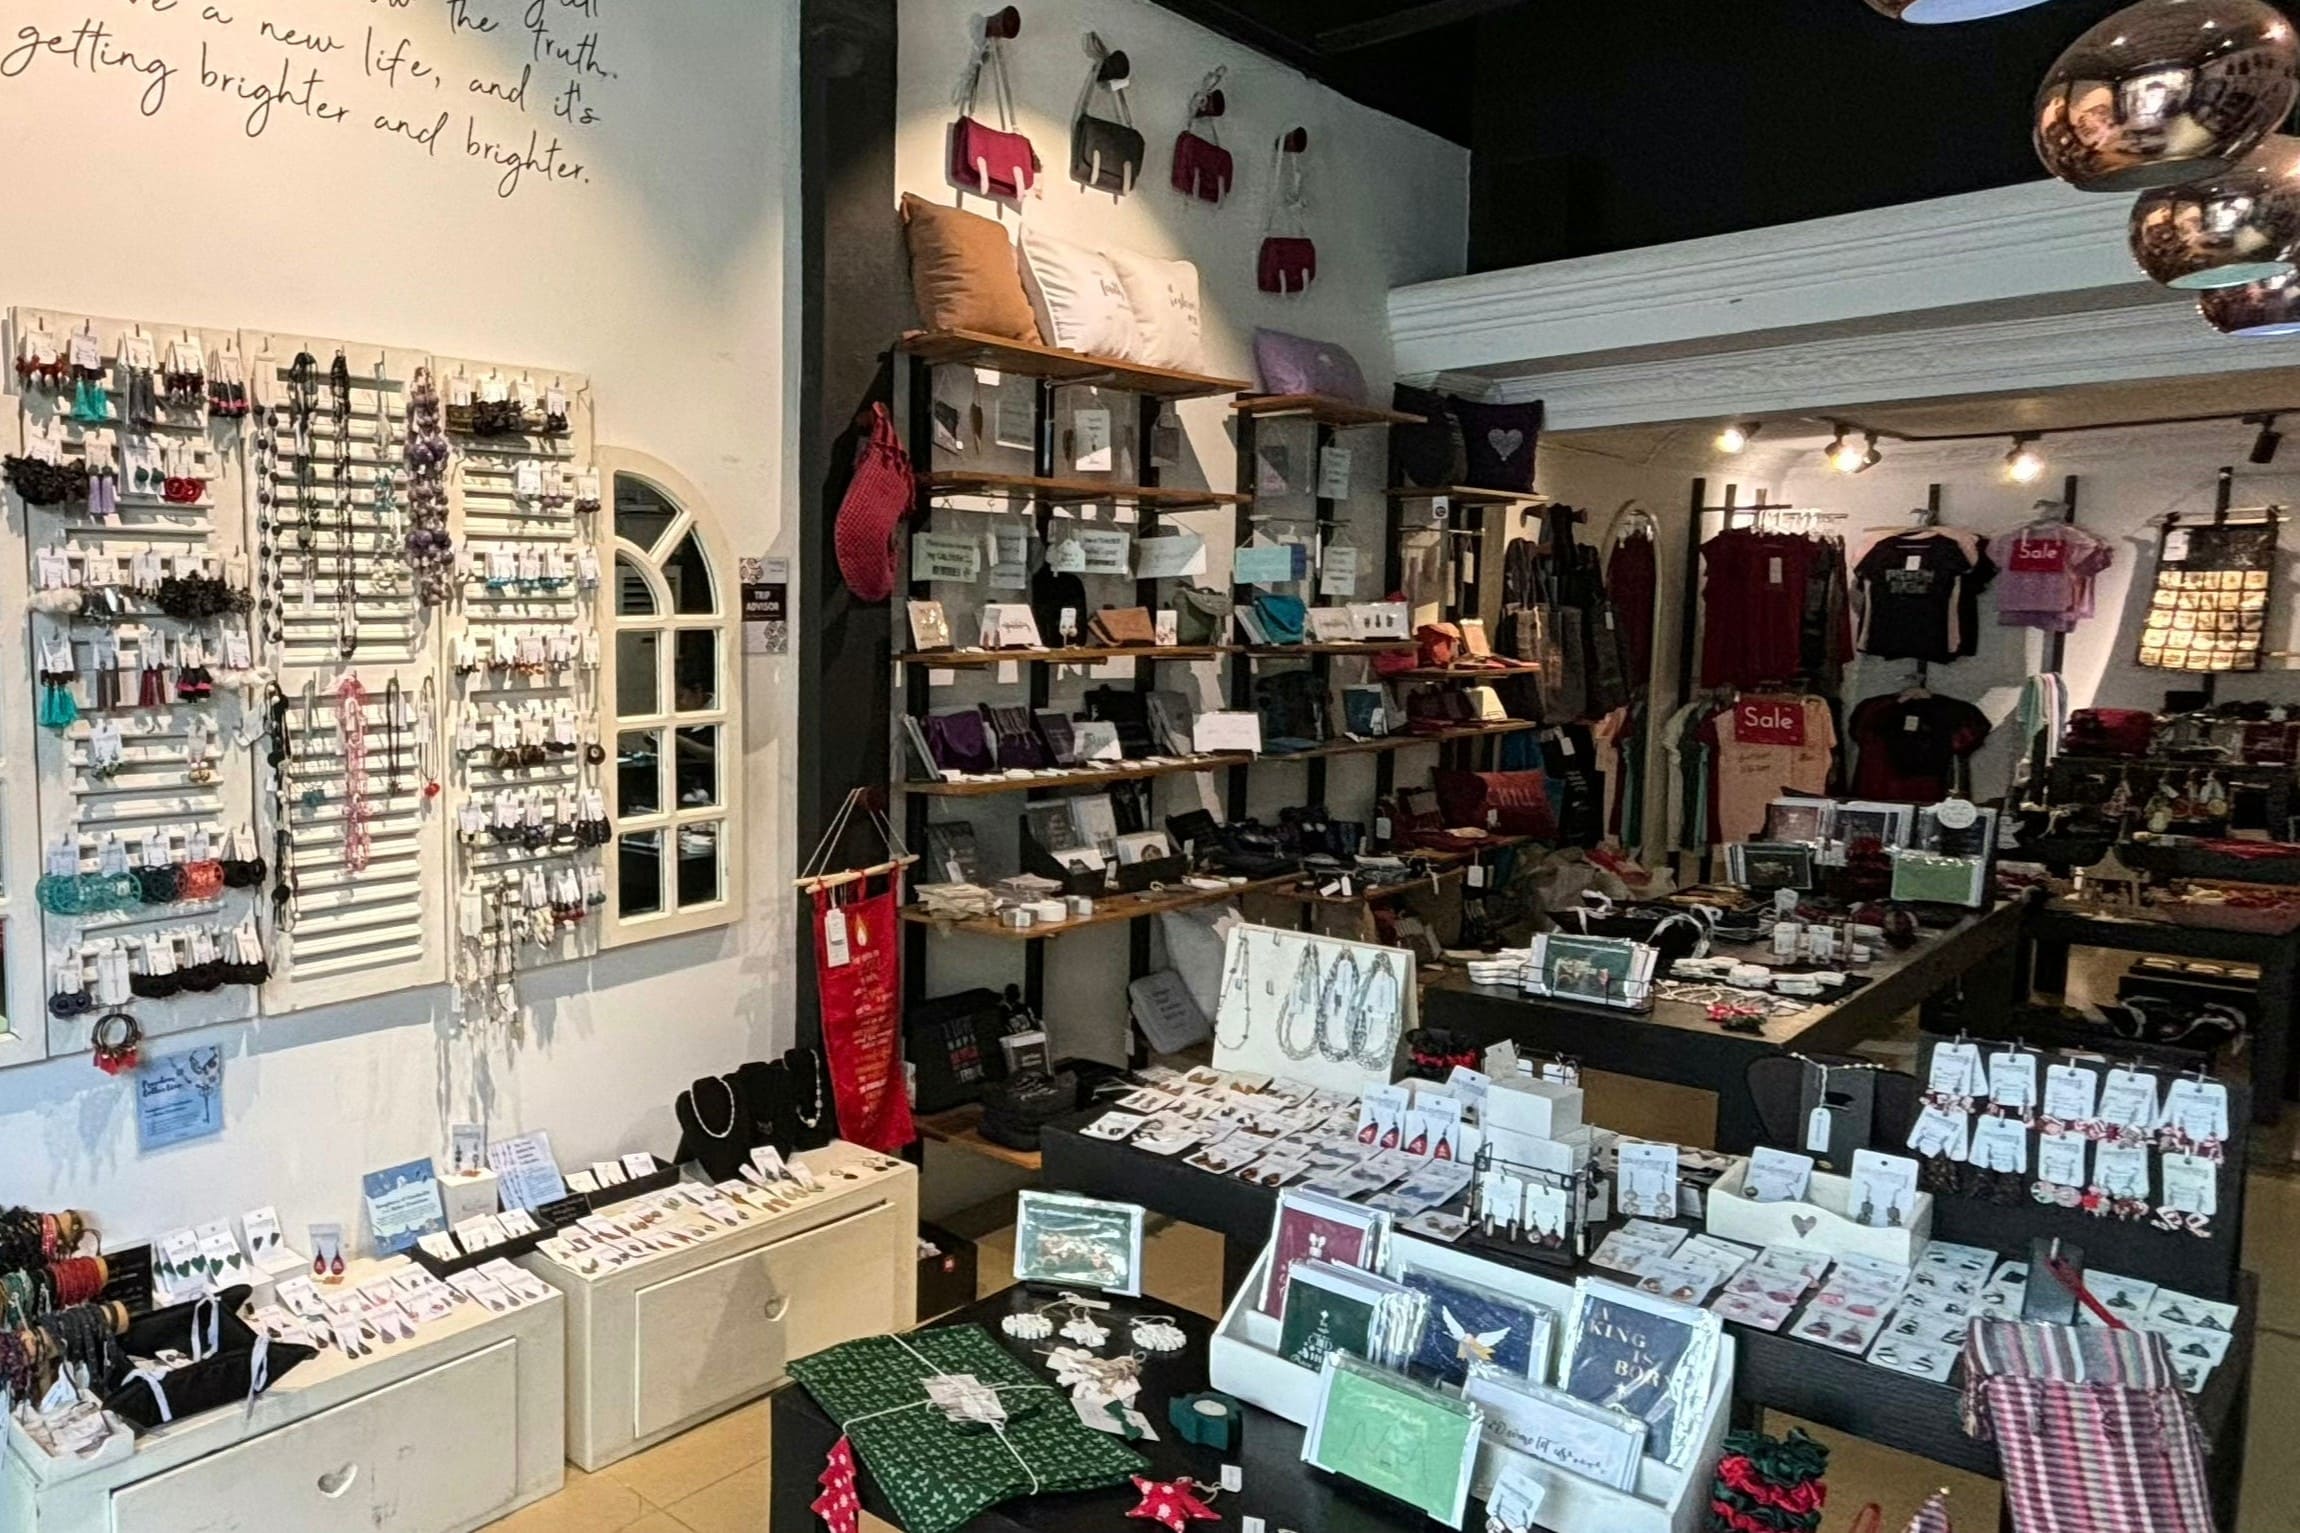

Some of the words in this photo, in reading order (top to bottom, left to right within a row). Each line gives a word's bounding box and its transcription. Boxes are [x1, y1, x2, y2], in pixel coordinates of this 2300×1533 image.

[202, 5, 233, 24] a
[260, 21, 344, 52] new
[365, 26, 440, 88] life,
[469, 64, 531, 112] and
[554, 79, 600, 124] it's
[447, 0, 498, 33] the
[532, 20, 618, 79] truth.
[1, 18, 178, 116] getting
[200, 41, 349, 138] brighter
[374, 112, 449, 156] and
[466, 116, 589, 198] brighter.
[2018, 542, 2059, 559] Sale
[1744, 706, 1794, 729] Sale
[1589, 1320, 1647, 1348] KING
